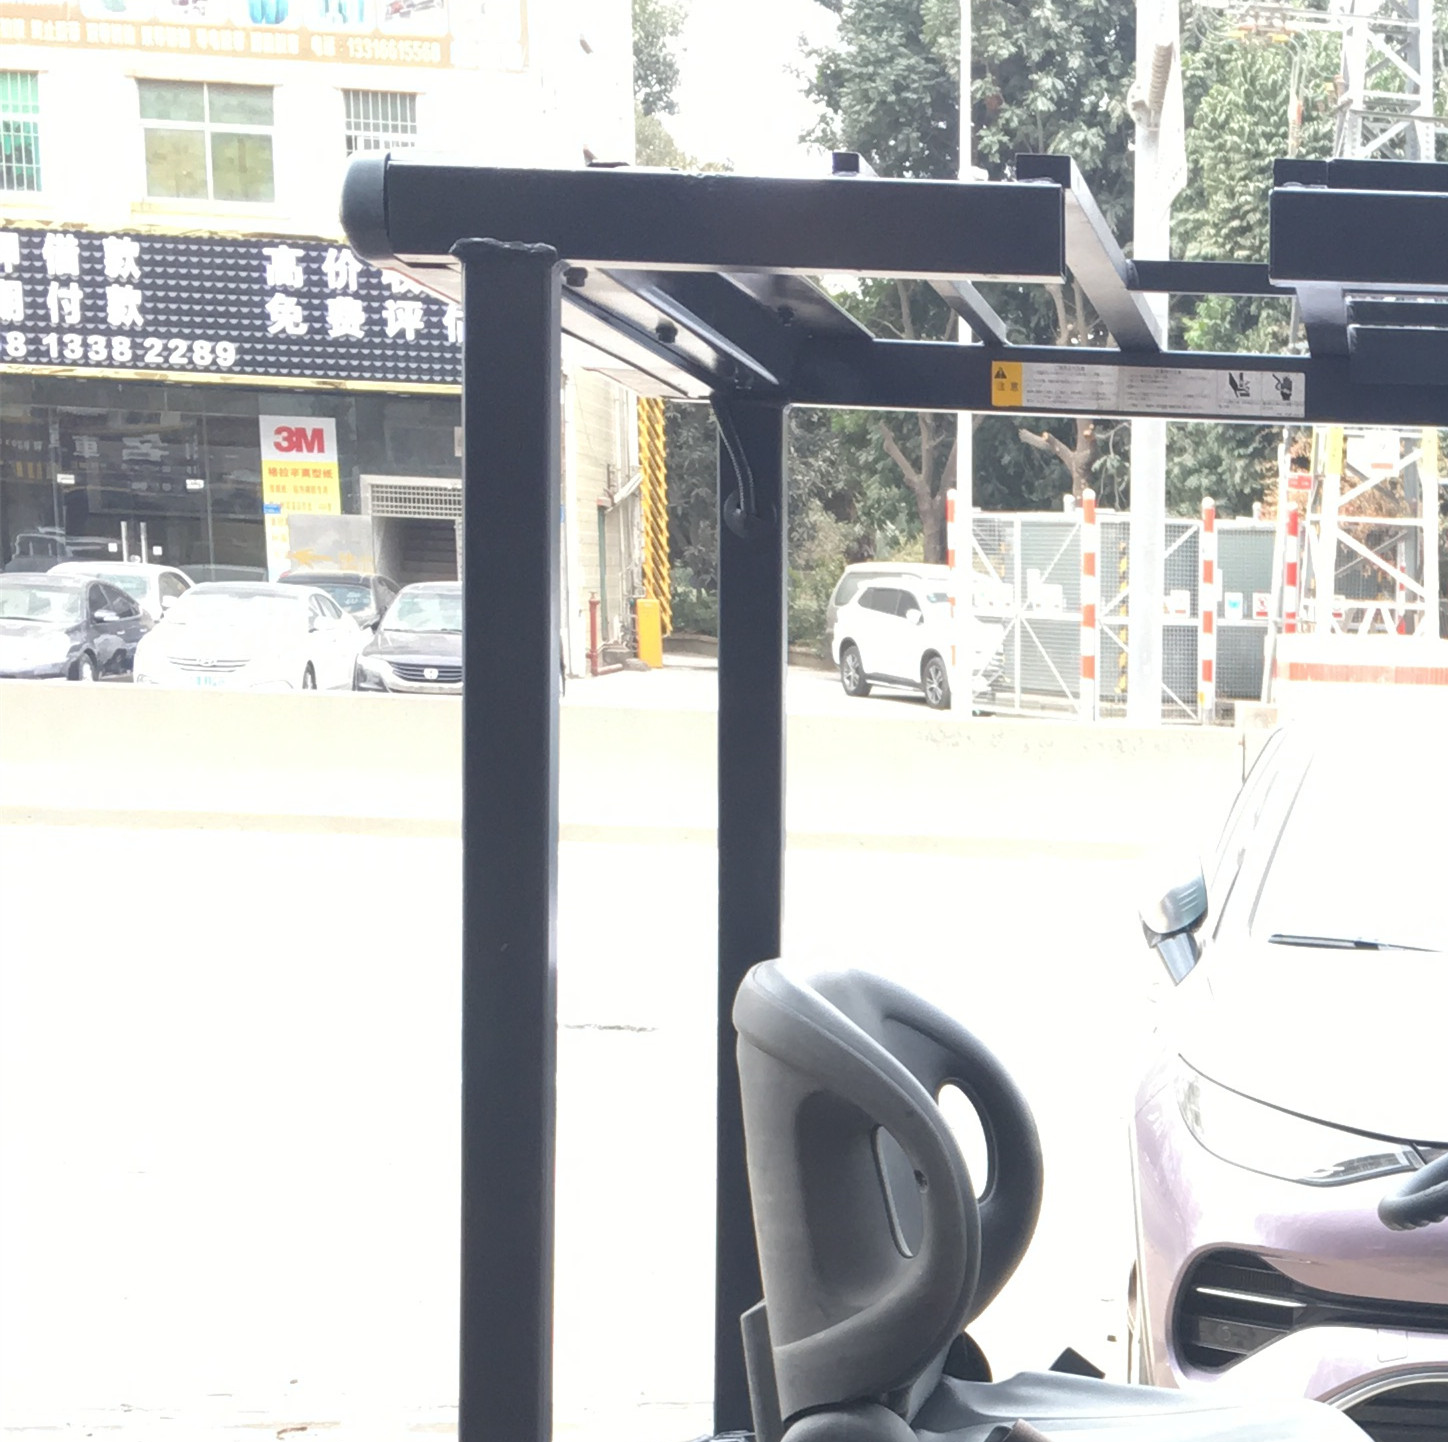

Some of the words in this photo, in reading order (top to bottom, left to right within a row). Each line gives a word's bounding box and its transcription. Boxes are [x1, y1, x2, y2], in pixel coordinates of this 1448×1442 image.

[42, 333, 133, 362] 1338
[143, 338, 236, 367] 2289
[273, 426, 325, 453] 3M
